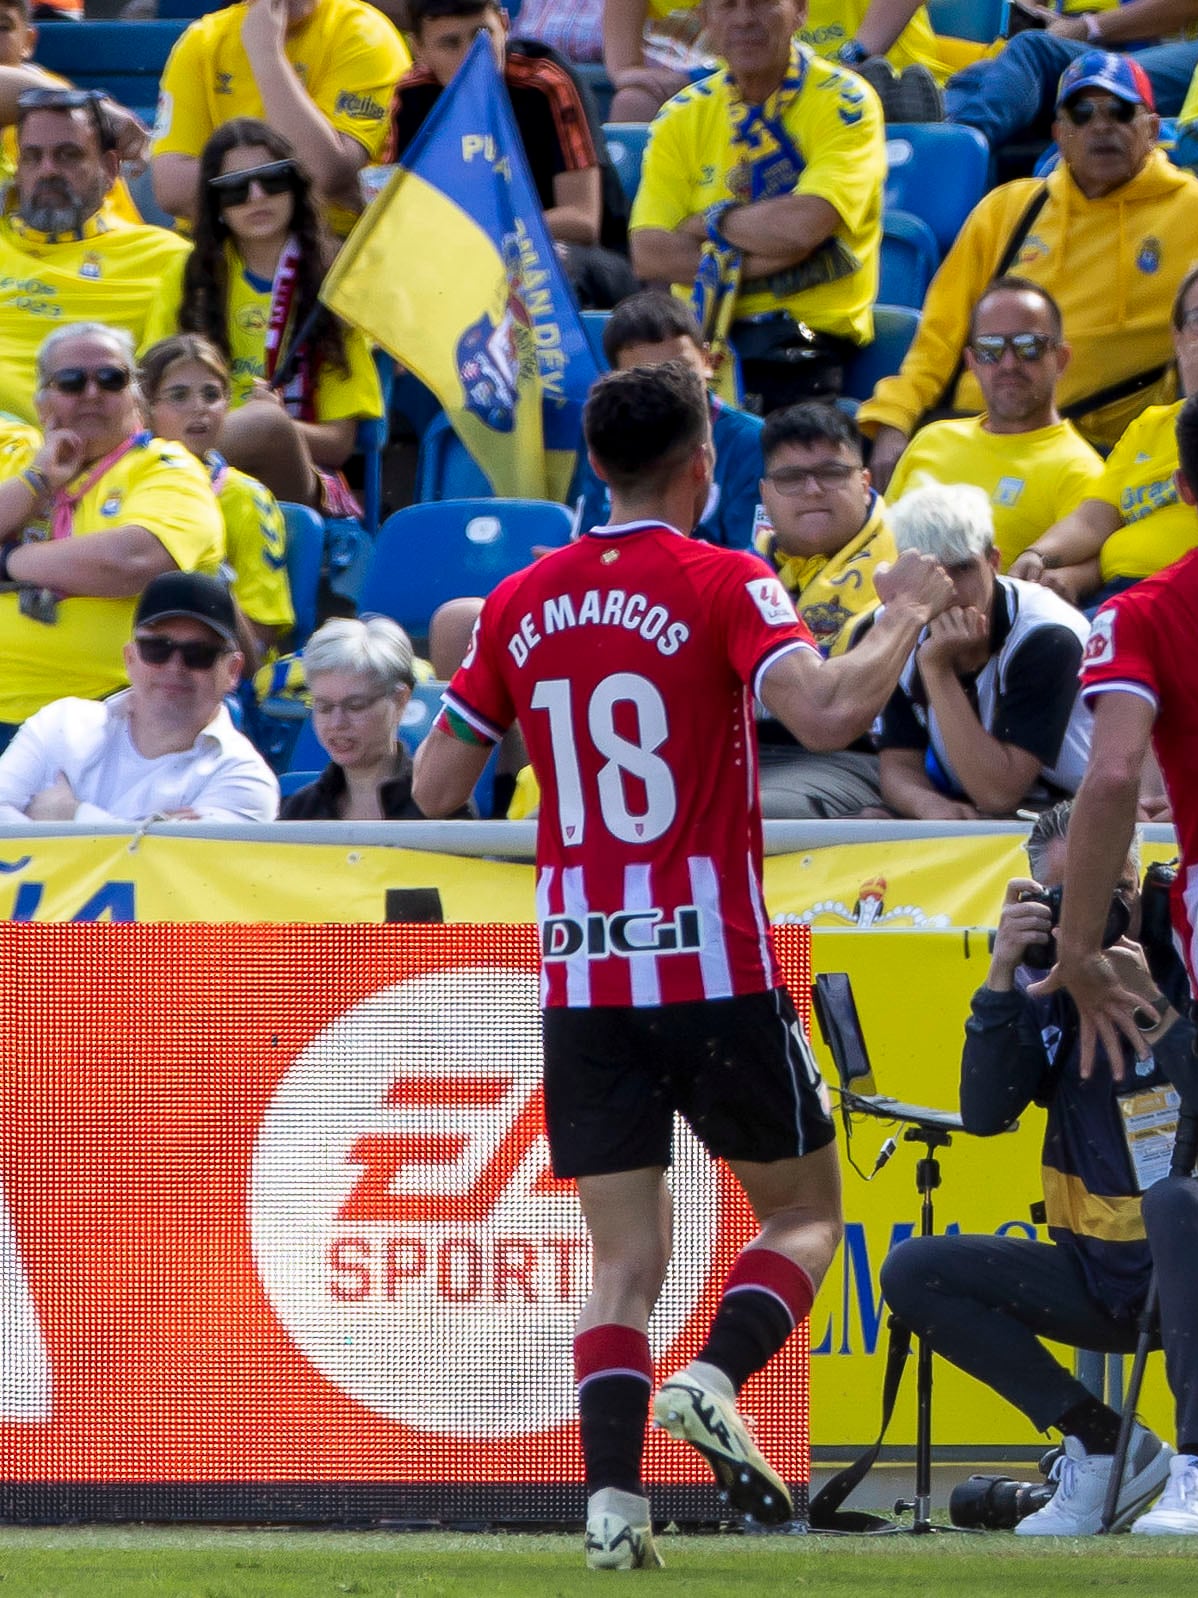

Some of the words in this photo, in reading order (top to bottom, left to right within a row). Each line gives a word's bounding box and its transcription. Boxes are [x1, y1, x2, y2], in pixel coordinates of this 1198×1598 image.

[508, 611, 542, 669] DE
[543, 589, 690, 657] MARCOS
[530, 672, 678, 848] 18
[541, 907, 702, 958] DIGI
[326, 1235, 592, 1302] SPORT
